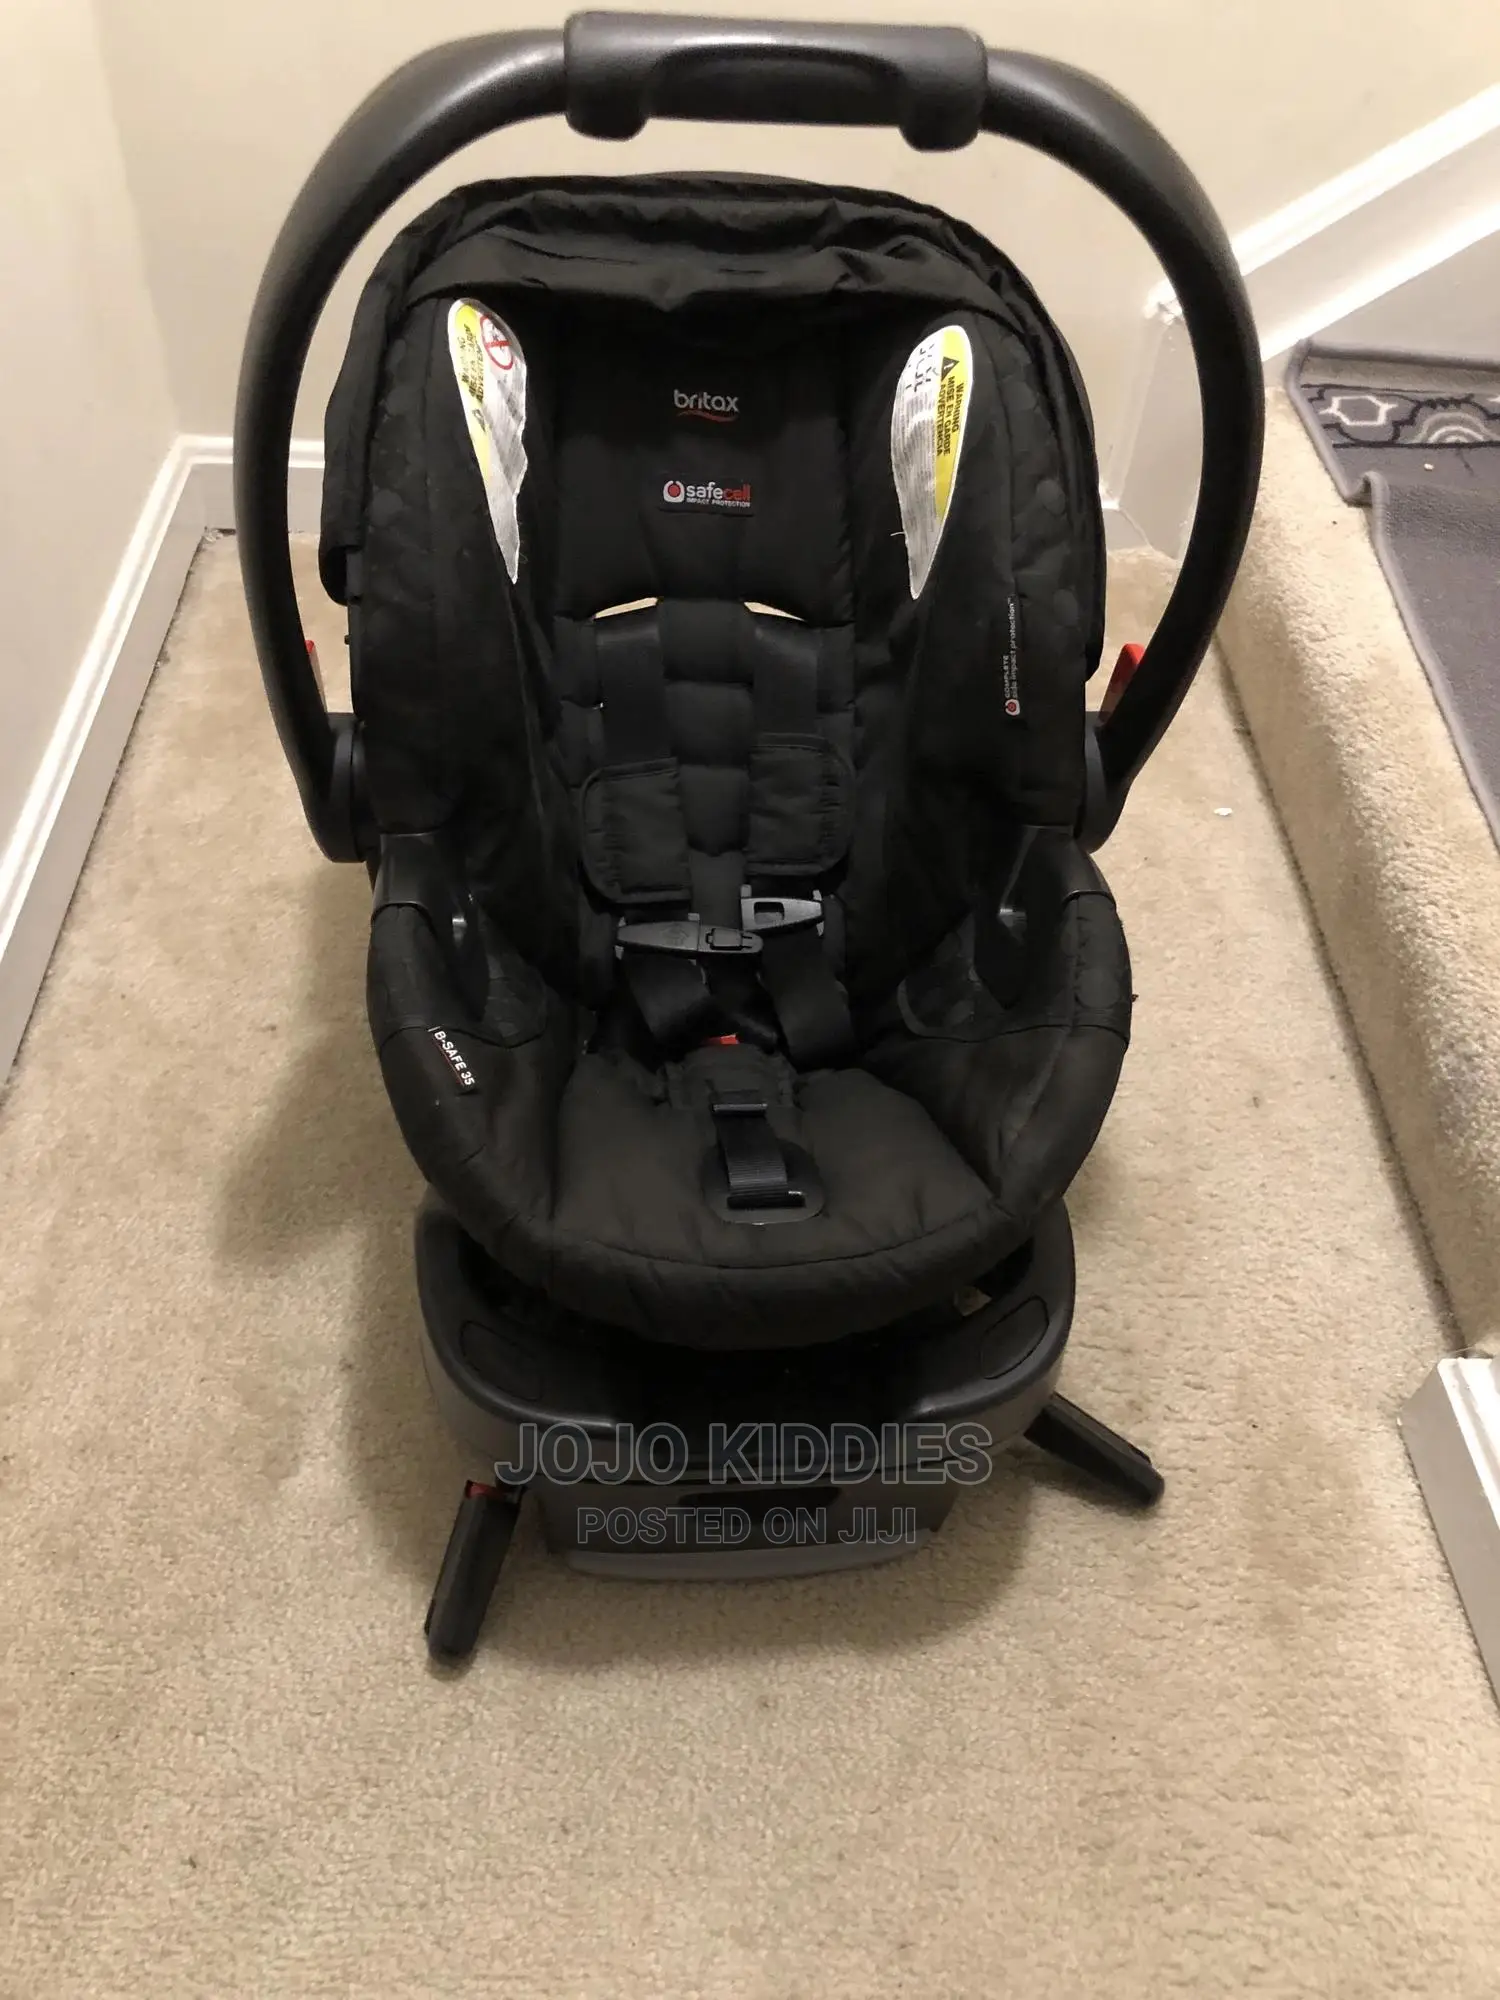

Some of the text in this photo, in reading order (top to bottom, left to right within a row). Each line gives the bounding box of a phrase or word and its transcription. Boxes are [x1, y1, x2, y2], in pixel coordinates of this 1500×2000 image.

[673, 389, 739, 412] britax
[936, 384, 946, 456] ADVERTENCIA
[943, 375, 955, 456] MISE EN GARDE
[952, 382, 965, 433] WARNING
[686, 481, 751, 500] safecell
[1010, 650, 1018, 680] impact
[434, 1030, 475, 1085] B-SAFE 35
